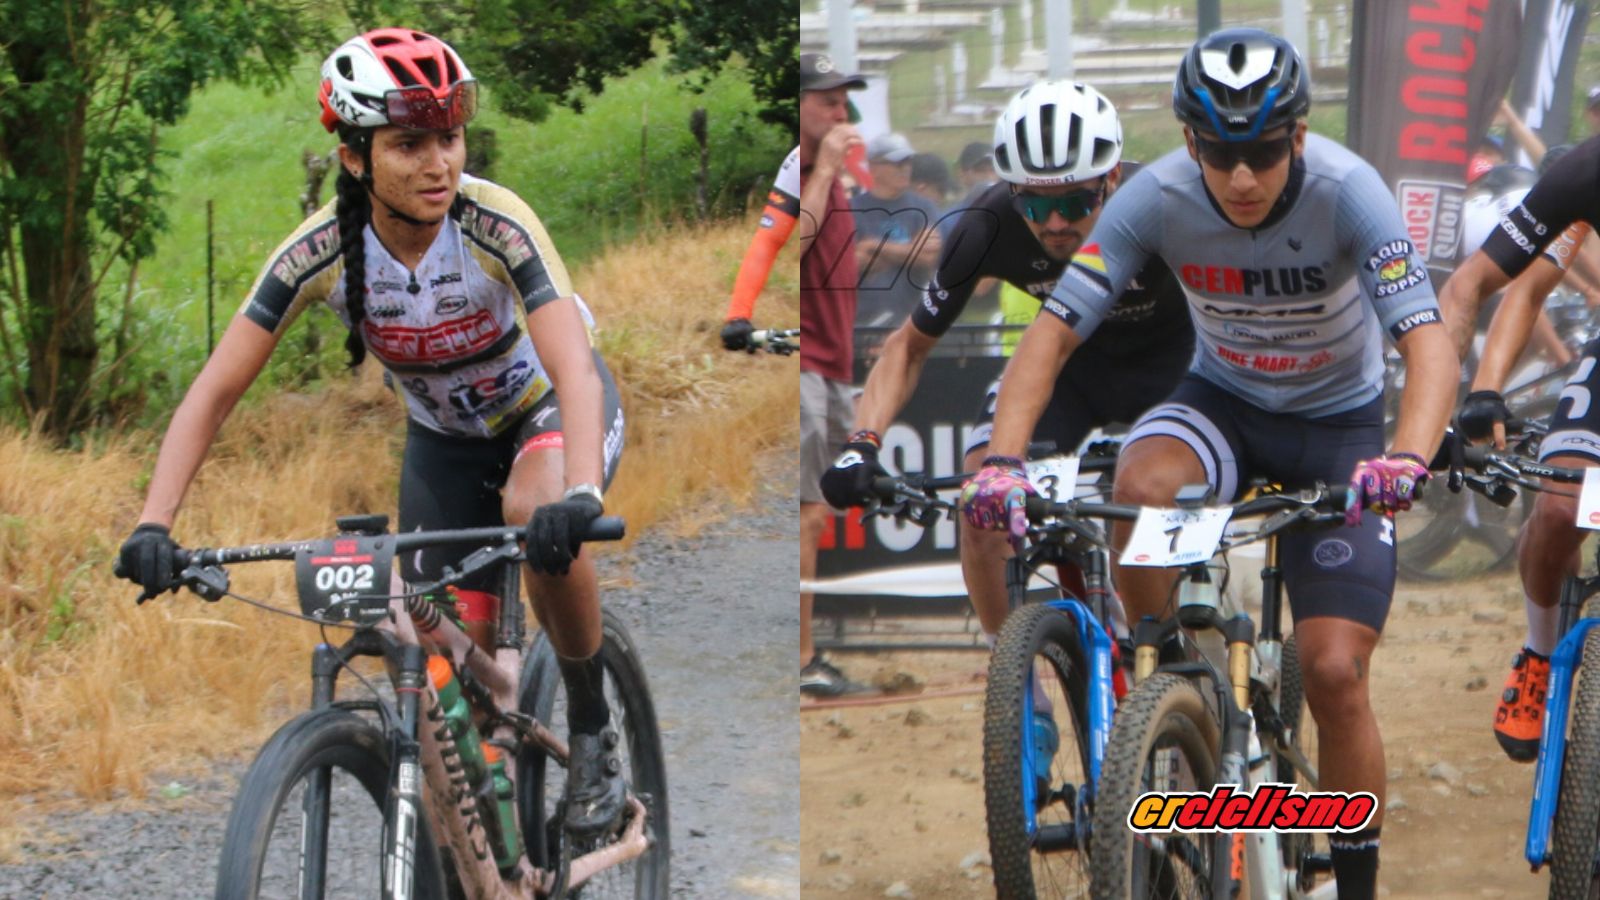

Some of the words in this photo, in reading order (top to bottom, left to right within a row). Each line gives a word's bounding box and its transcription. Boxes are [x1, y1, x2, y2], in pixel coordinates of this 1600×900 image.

[1369, 240, 1411, 270] AQUI
[1377, 267, 1425, 297] SOPAS
[1398, 310, 1437, 332] uvex
[1217, 344, 1249, 367] BIKE
[1252, 354, 1299, 373] MART
[1037, 474, 1060, 502] 3
[315, 563, 375, 592] 002
